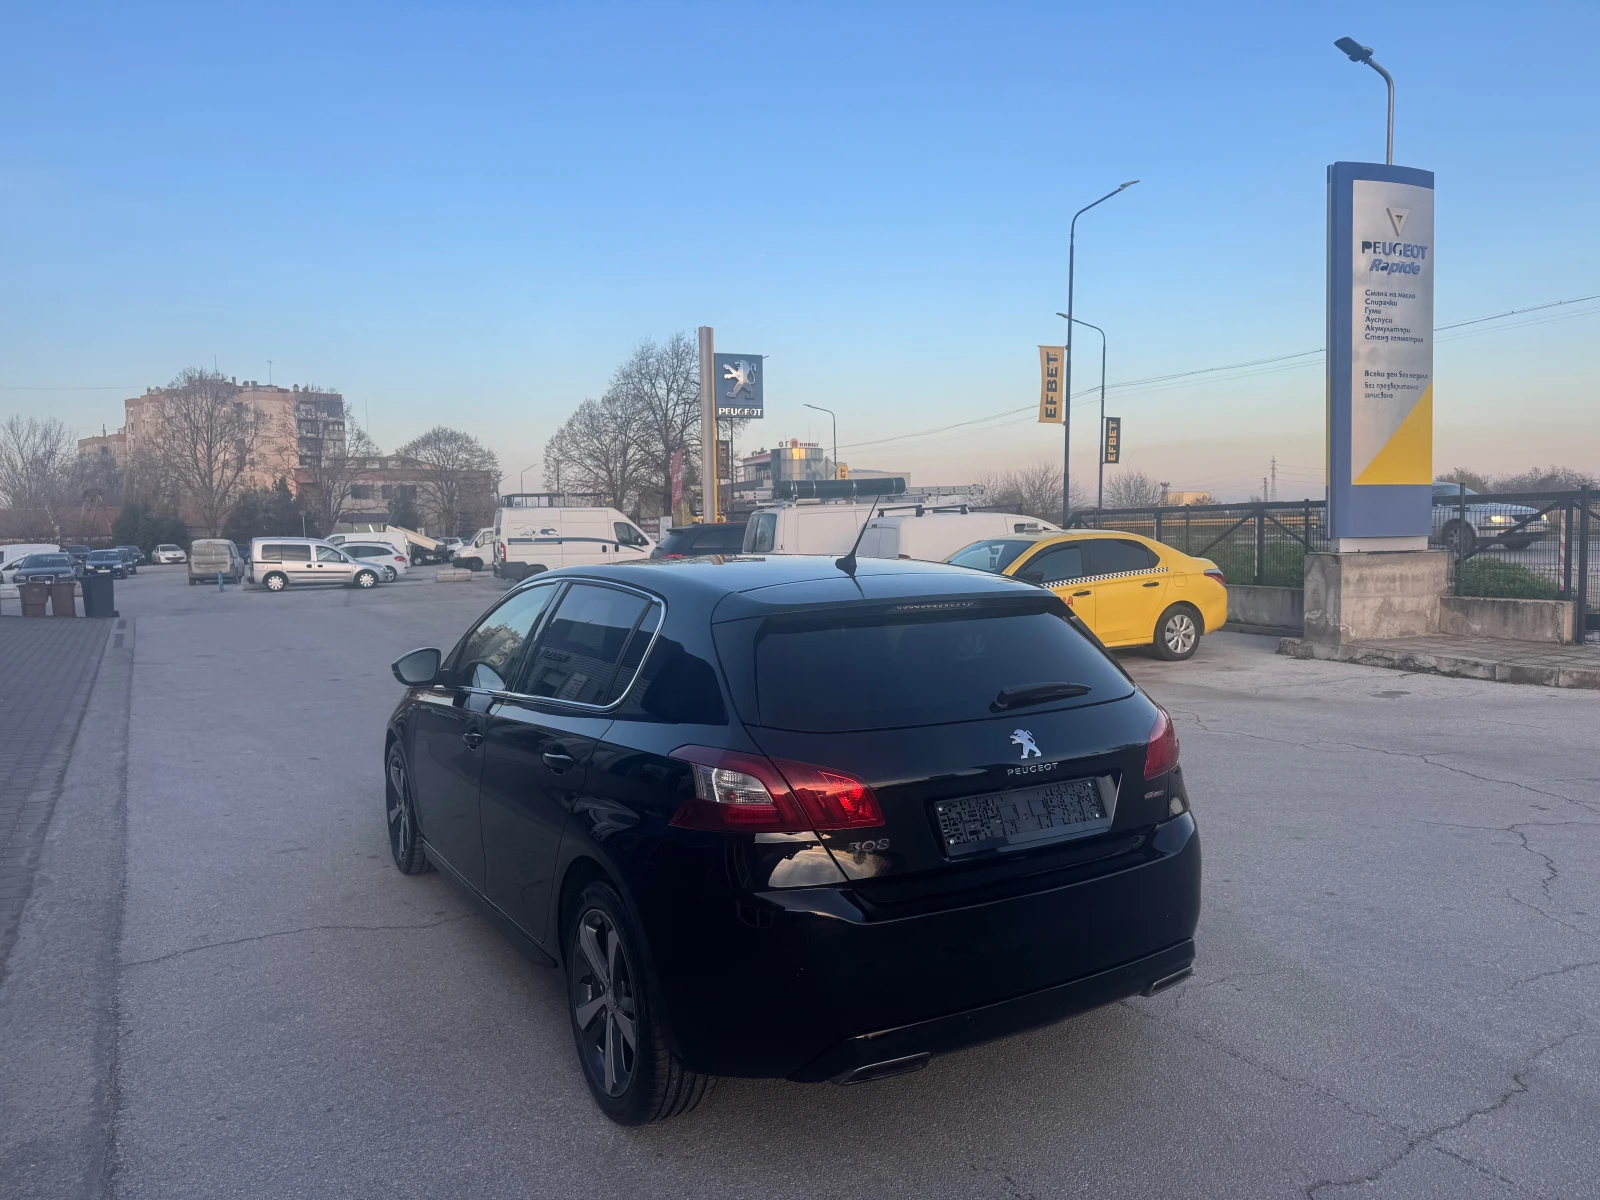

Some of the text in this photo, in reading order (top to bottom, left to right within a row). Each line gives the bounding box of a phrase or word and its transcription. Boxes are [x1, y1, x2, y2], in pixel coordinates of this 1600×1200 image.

[1361, 241, 1428, 259] PEUGEOT
[1369, 258, 1421, 275] Rapide
[1365, 289, 1387, 297] Смяна
[1365, 298, 1398, 307] Спирачки
[1365, 306, 1382, 315] Гуми
[1365, 316, 1393, 324] Ауспуси
[1045, 351, 1059, 418] EFBET
[718, 407, 762, 416] PEUGEOT
[1107, 421, 1117, 461] EFBET
[1007, 762, 1059, 776] PEUGEOT
[848, 838, 890, 852] 308
